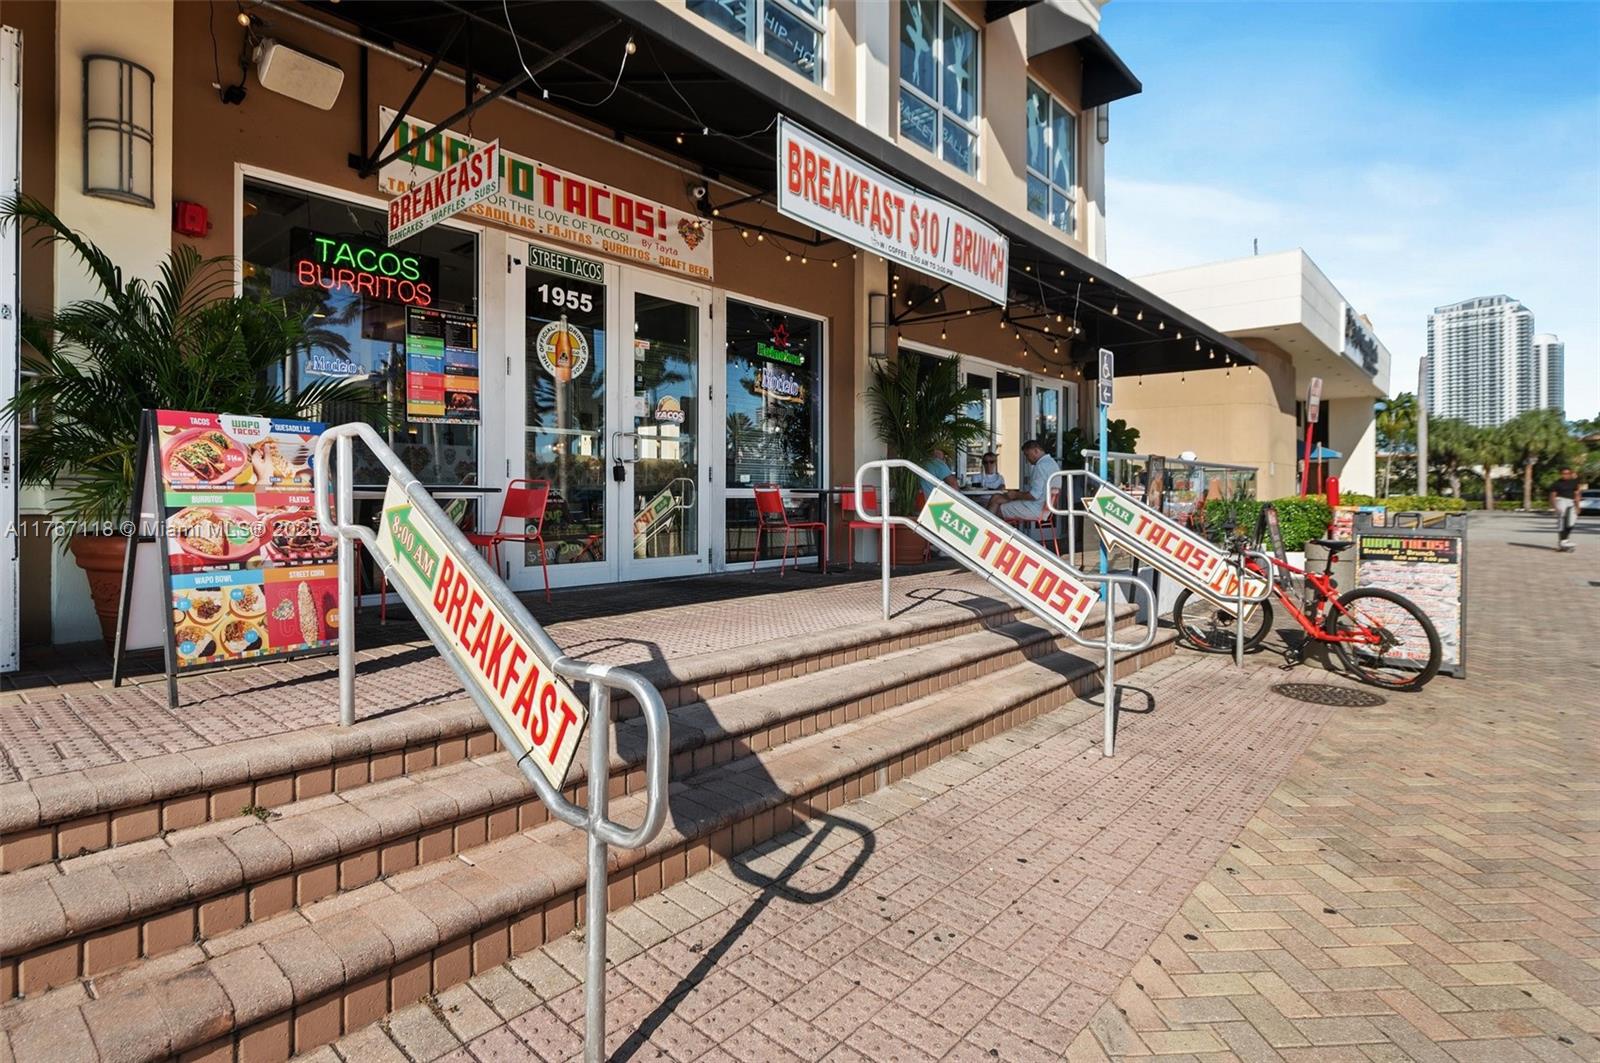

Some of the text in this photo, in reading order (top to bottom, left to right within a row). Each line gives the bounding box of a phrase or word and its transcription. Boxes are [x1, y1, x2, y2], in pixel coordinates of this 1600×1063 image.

[390, 144, 496, 231] BREAKFAST
[389, 181, 496, 244] PANCAKES WAFFLES SUBS
[509, 200, 534, 216] THE
[538, 208, 569, 226] LOVE
[572, 220, 588, 232] OF
[591, 223, 629, 243] TACOS!
[787, 139, 1005, 288] BREAKFAST $10 BRUNCH
[315, 237, 420, 281] TACOS
[532, 249, 601, 280] STREET TACOS
[546, 224, 592, 245] FAJITAS
[602, 239, 650, 260] BURRITOS
[688, 265, 709, 277] BEER
[641, 239, 653, 249] By
[298, 260, 432, 306] BURRITOS
[537, 284, 593, 313] 1955
[189, 417, 211, 426] TACOS
[231, 419, 260, 429] WAPO
[274, 424, 311, 433] QUESADILLAS
[655, 410, 685, 424] TACOS
[940, 510, 972, 540] BAR
[1104, 502, 1130, 522] BAR
[392, 511, 435, 579] 8:00 AM
[1135, 514, 1218, 577] TACOS!
[194, 574, 233, 585] WAPO BOWL
[978, 527, 1091, 624] TACOS!
[432, 553, 578, 766] BREAKFAST
